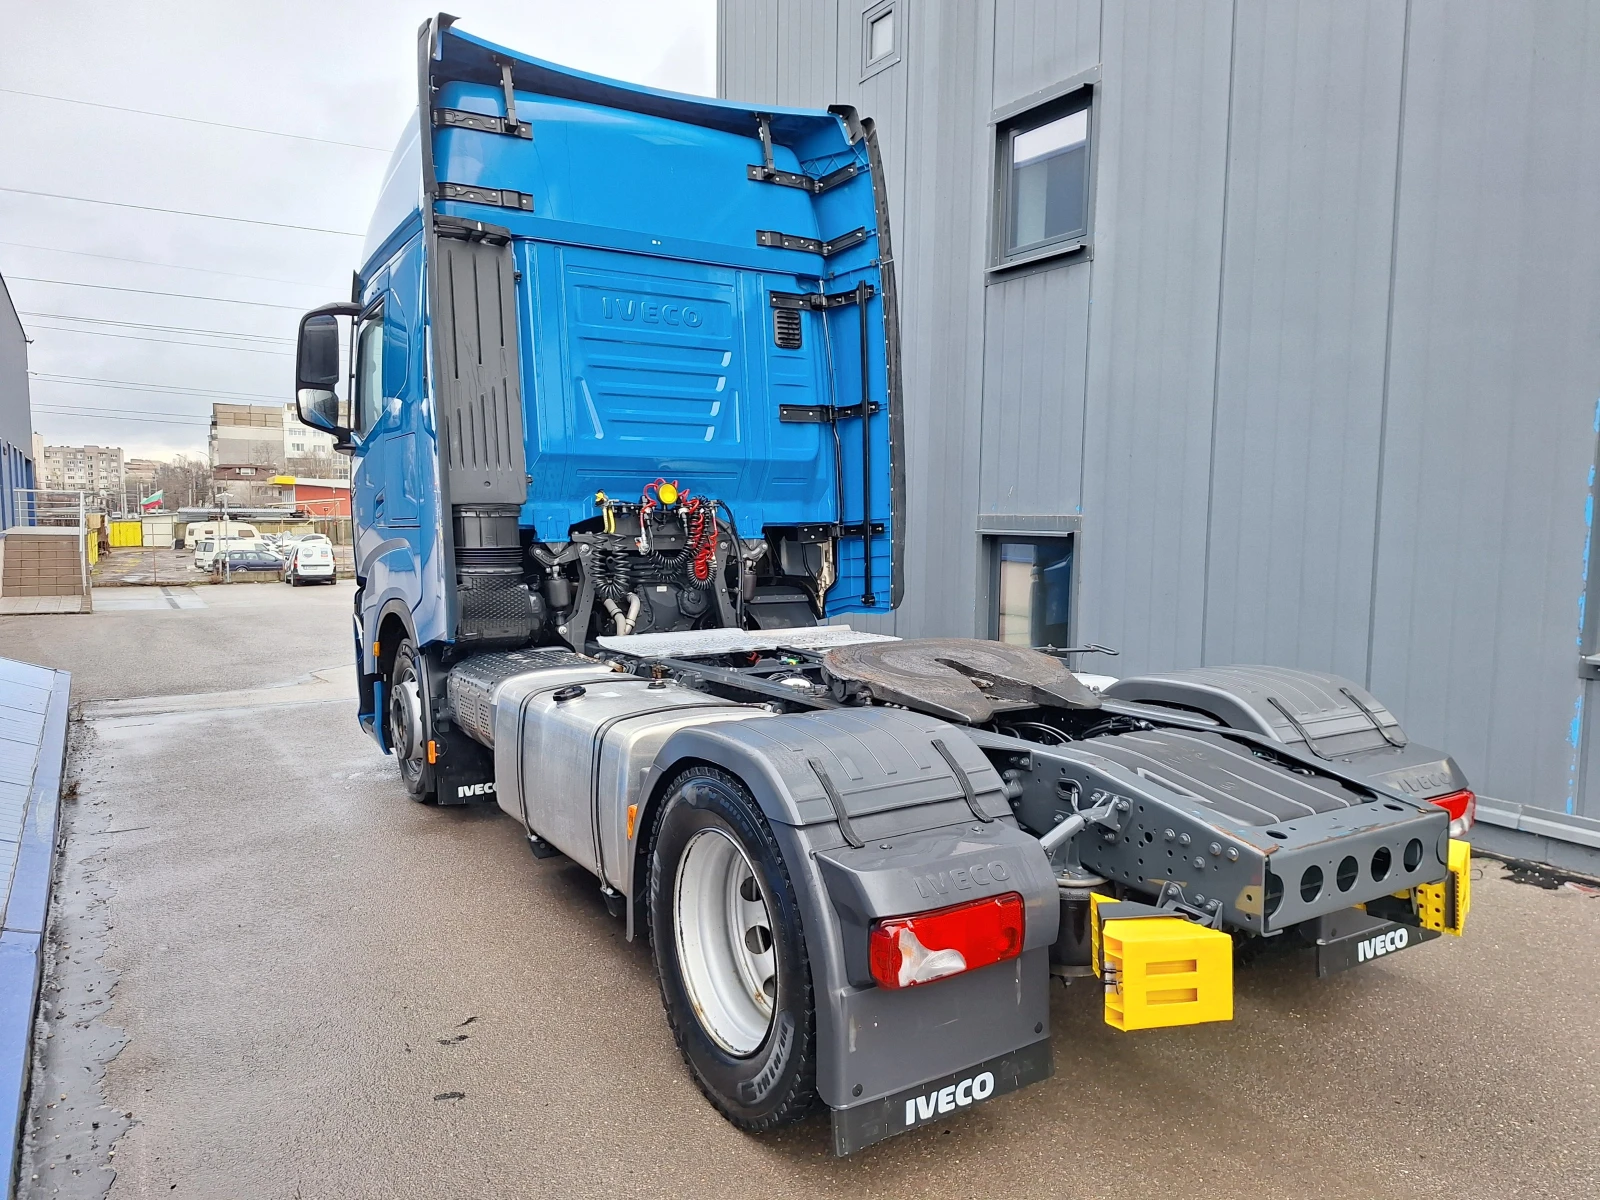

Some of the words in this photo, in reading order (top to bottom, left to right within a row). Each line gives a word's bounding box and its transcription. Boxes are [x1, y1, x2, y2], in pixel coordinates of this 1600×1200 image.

[602, 297, 703, 328] IVECO
[912, 861, 1010, 898] IVECO
[1357, 927, 1409, 963] IVECO
[905, 1071, 995, 1126] IVECO
